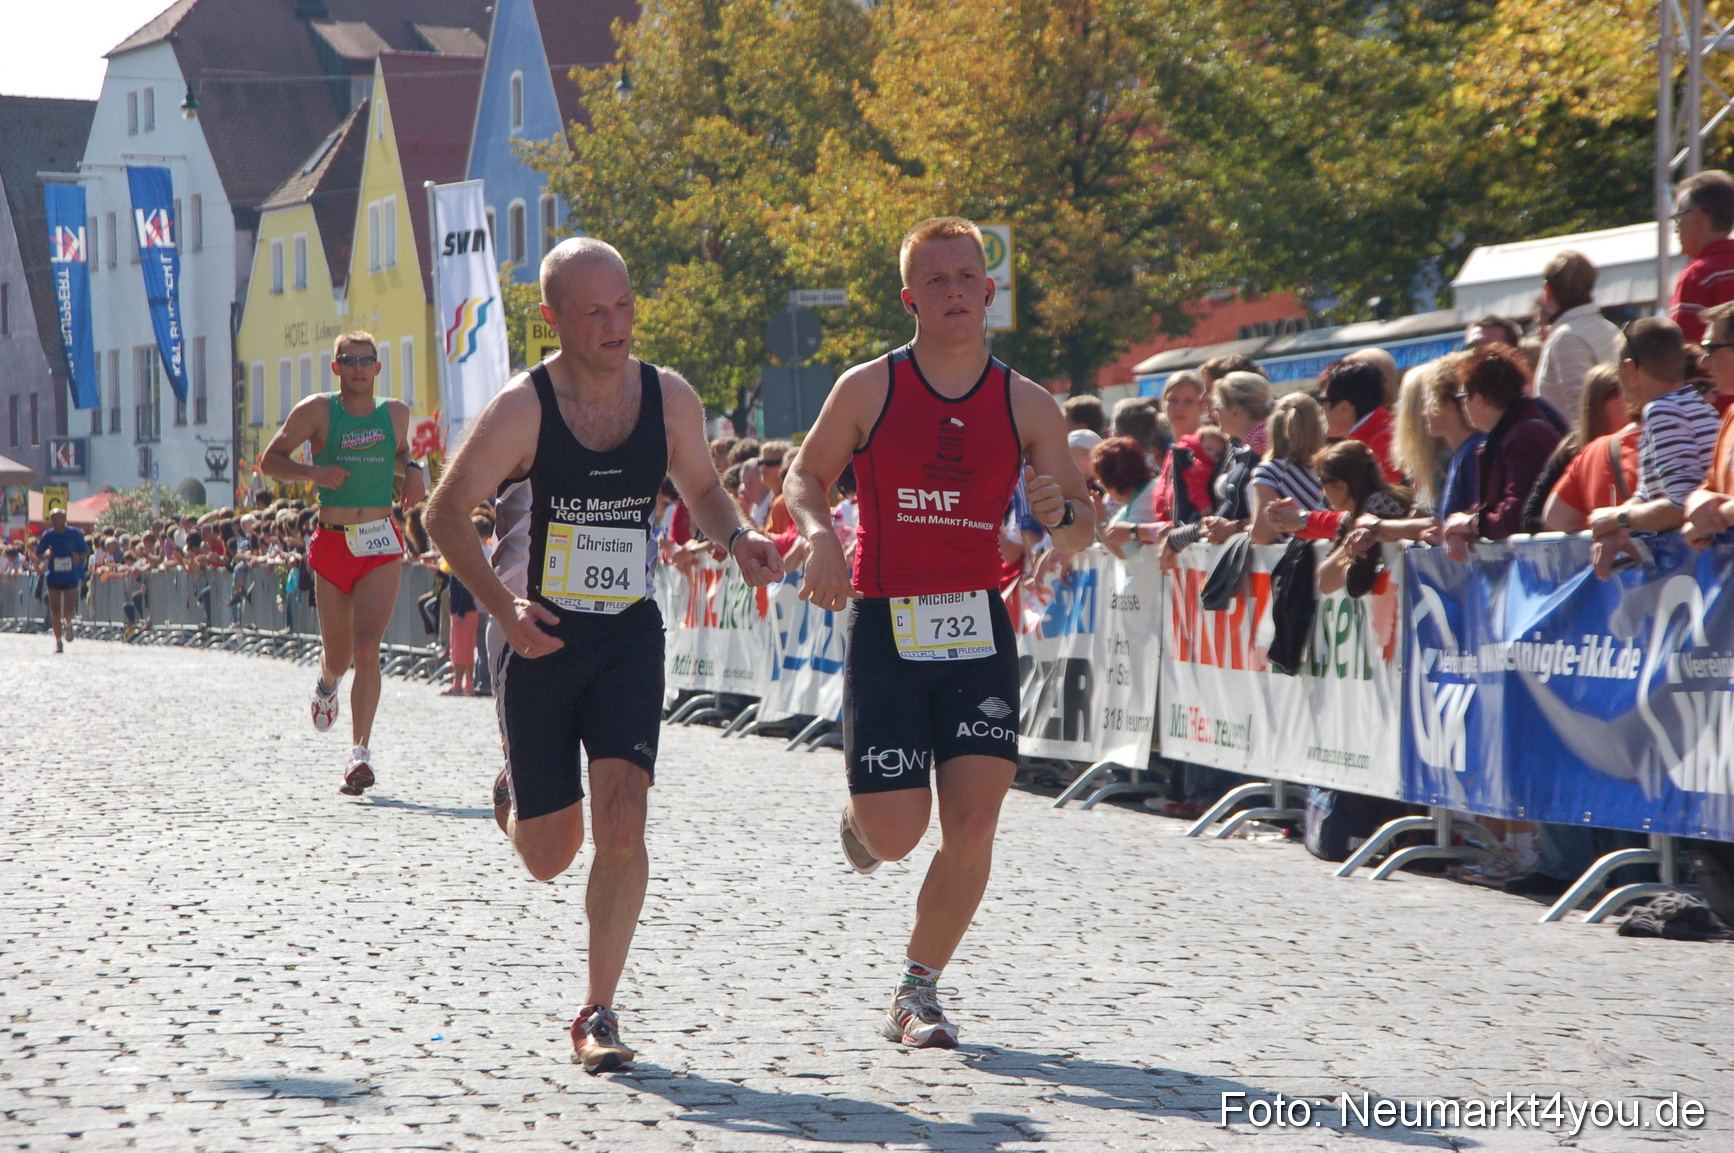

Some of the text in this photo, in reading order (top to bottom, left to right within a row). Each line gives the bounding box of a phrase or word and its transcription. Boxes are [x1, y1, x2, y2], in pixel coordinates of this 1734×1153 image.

[284, 321, 309, 347] HOTEL
[551, 496, 651, 511] LLC Marathon
[897, 488, 960, 512] SMF
[556, 508, 642, 524] Regensburg
[366, 536, 390, 550] 290
[576, 533, 634, 553] Christian
[549, 556, 557, 569] B
[584, 566, 631, 591] 894
[918, 592, 965, 606] Michael
[897, 615, 903, 627] C
[930, 615, 977, 640] 732
[958, 646, 994, 655] PFLEIDERER
